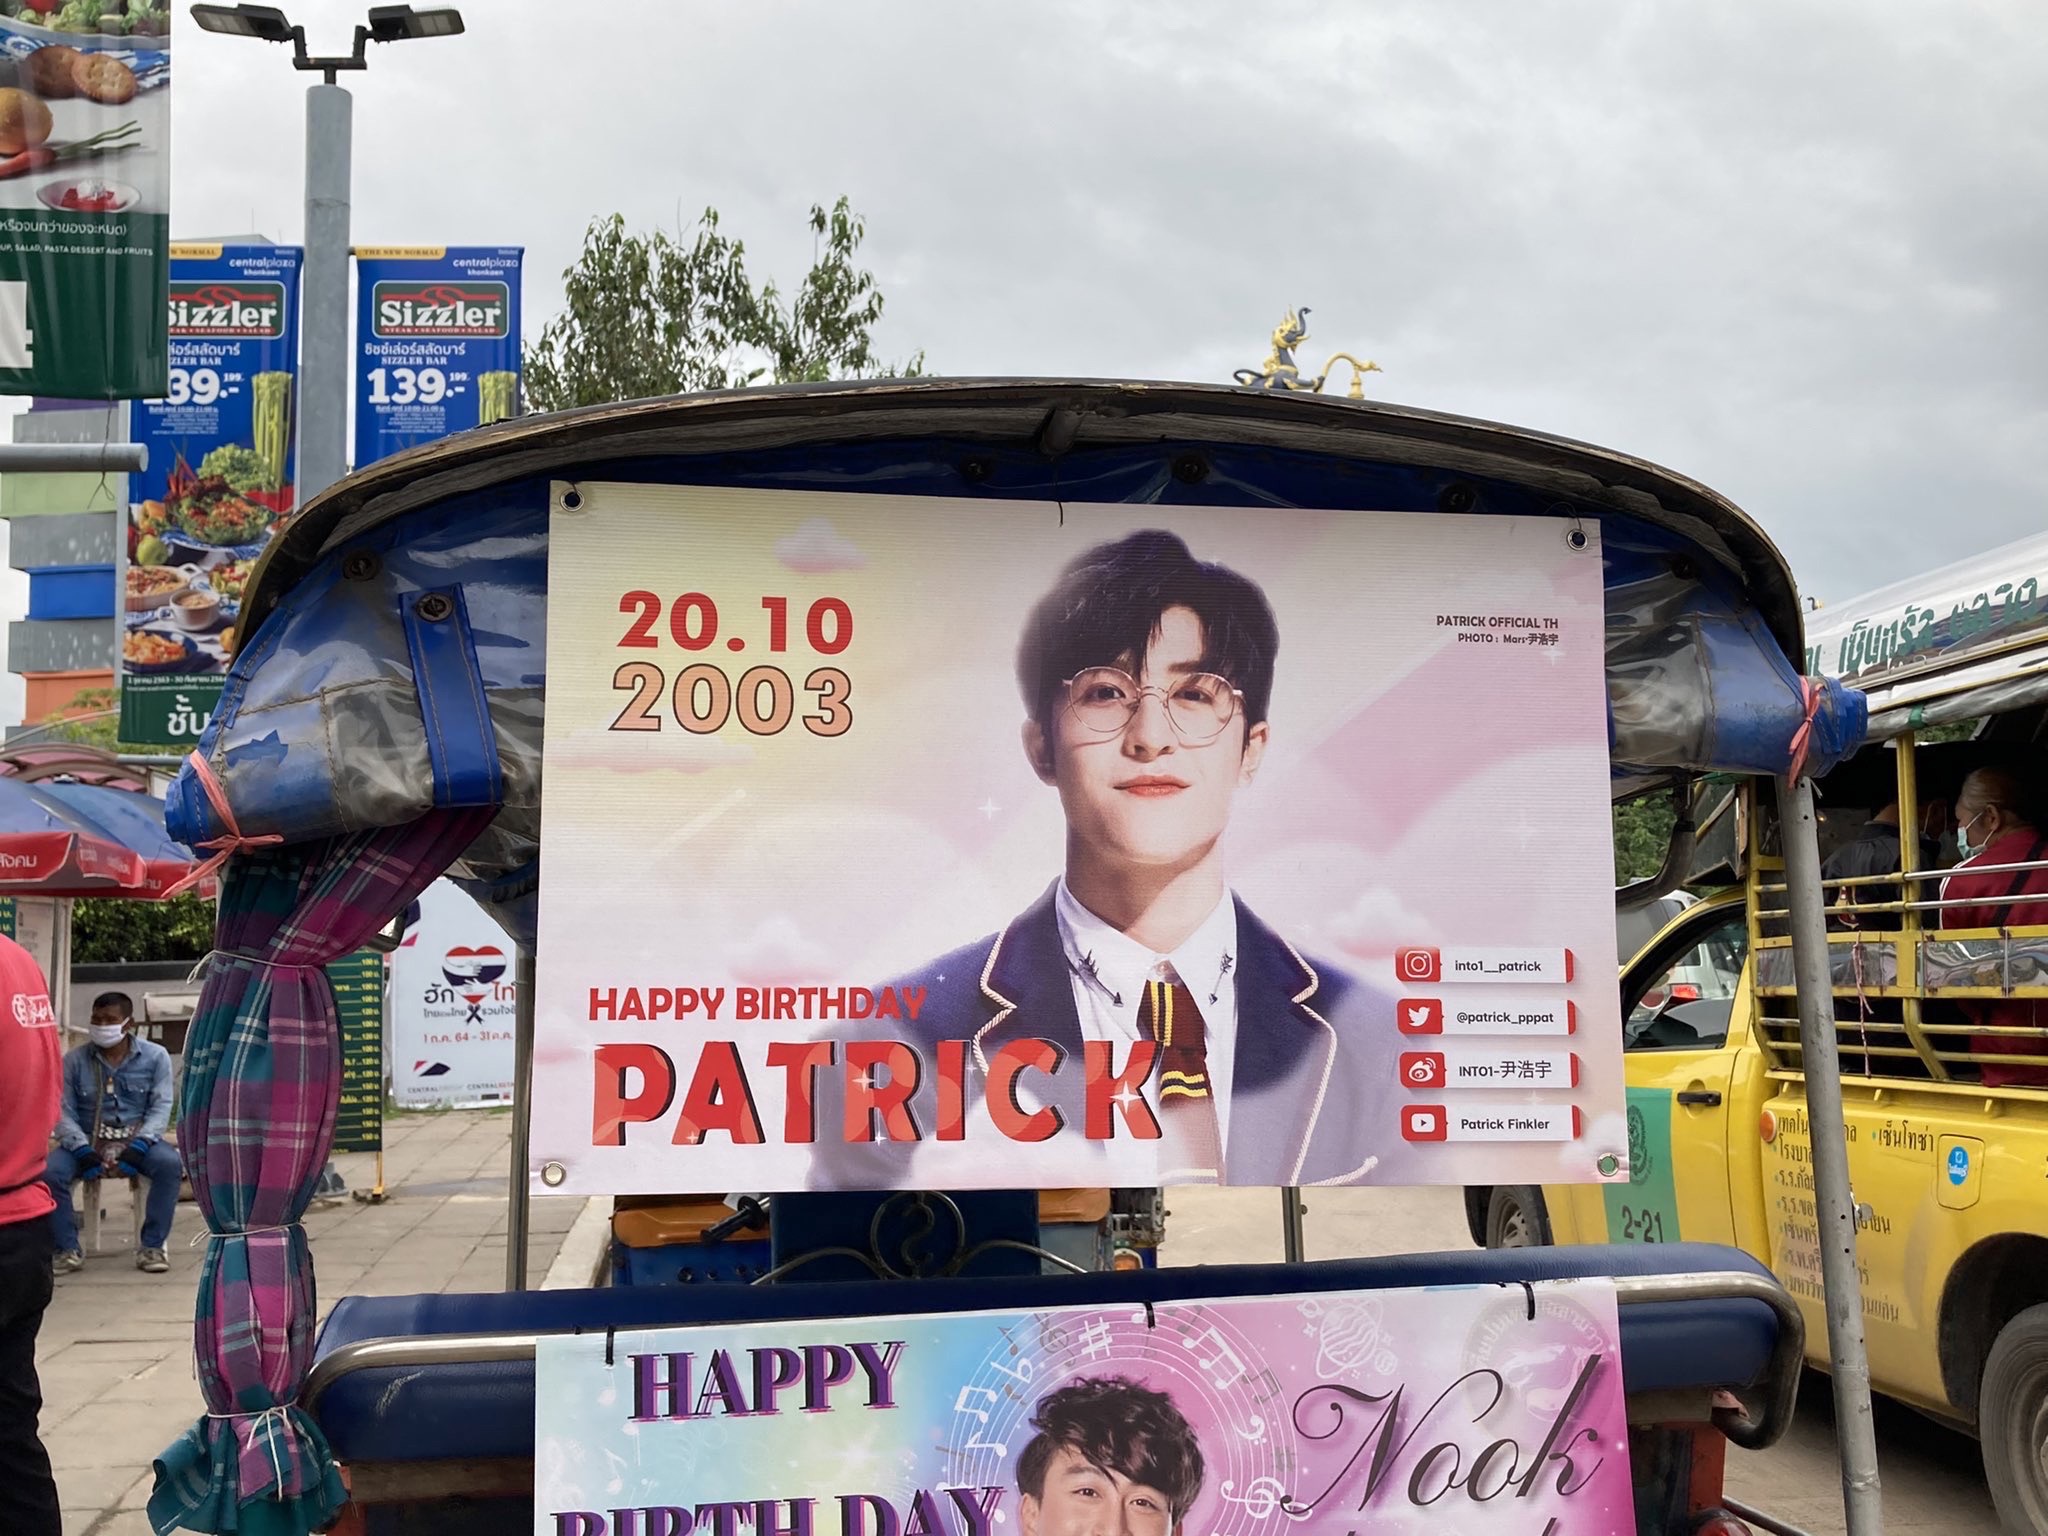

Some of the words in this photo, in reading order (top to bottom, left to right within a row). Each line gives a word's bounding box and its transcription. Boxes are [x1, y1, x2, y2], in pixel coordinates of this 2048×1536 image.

[44, 244, 69, 253] PASTA
[71, 246, 105, 254] DESSERT
[106, 247, 123, 255] AND
[124, 247, 154, 256] FRUITS
[229, 257, 296, 269] centralplaza
[453, 257, 519, 269] centralplaza
[380, 300, 502, 327] Sizzler
[200, 356, 222, 366] BAR
[381, 356, 423, 366] SIZZLER
[426, 356, 448, 366] BAR
[617, 590, 853, 655] 20.10
[1436, 615, 1486, 627] PATRICK
[1488, 616, 1541, 628] OFFICIAL
[1543, 618, 1559, 629] TH
[1458, 633, 1494, 643] PHOTO
[608, 661, 853, 737] 2003
[588, 986, 724, 1022] HAPPY
[736, 986, 928, 1022] BIRTHDAY
[1457, 1012, 1554, 1025] @patrick_pppat
[455, 1032, 469, 1042] 64
[1459, 1060, 1552, 1079] INTO1-尹浩宇
[591, 1038, 1167, 1147] PATRICK
[1461, 1118, 1504, 1130] Patrick
[1508, 1118, 1550, 1130] Finkler
[1622, 1205, 1663, 1243] 2-21
[627, 1341, 910, 1422] HAPPY
[1279, 1354, 1605, 1514] Nook
